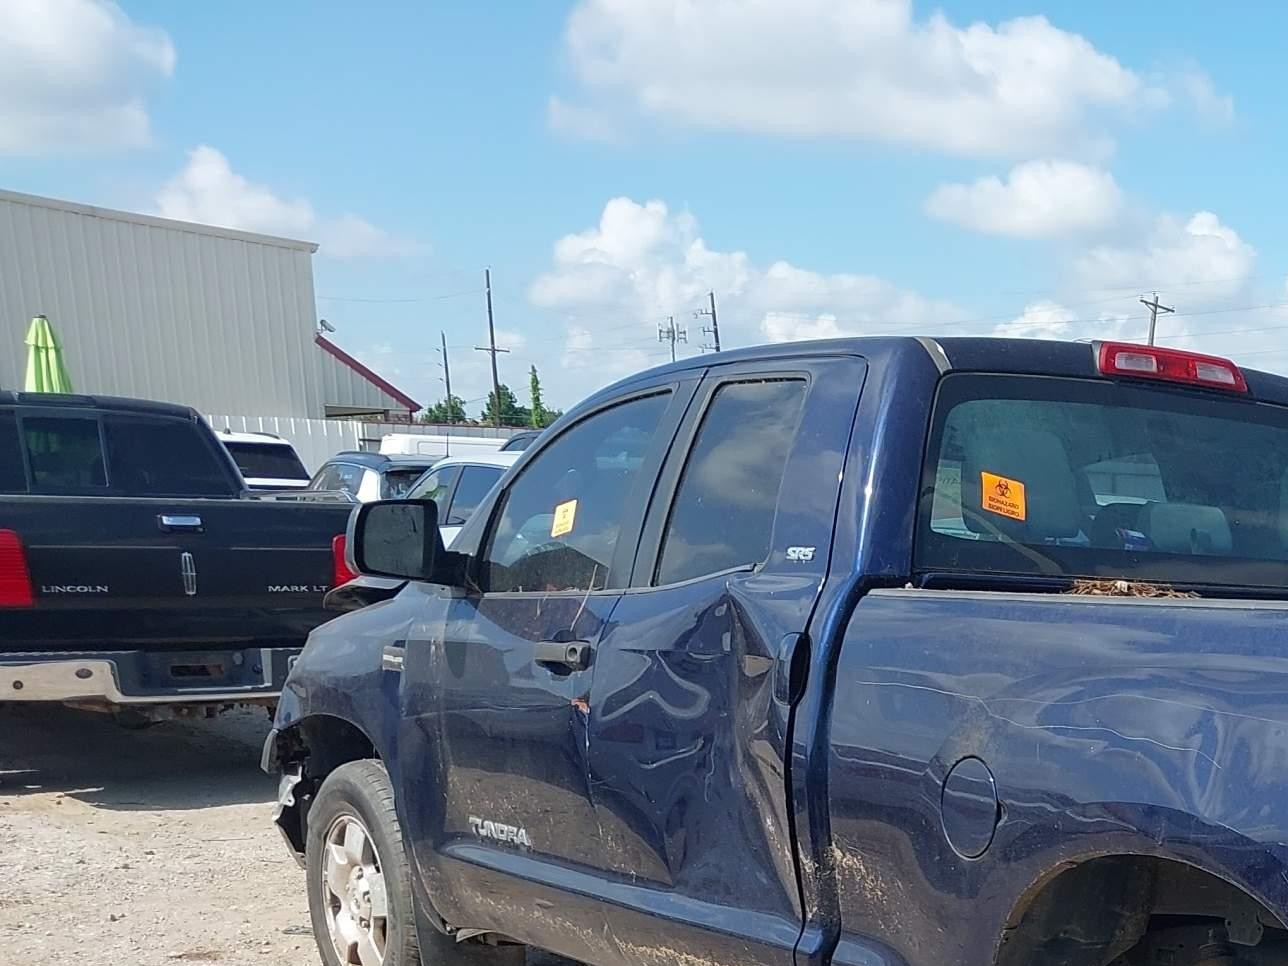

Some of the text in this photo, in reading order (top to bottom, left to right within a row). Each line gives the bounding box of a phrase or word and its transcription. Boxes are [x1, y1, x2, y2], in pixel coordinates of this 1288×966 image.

[786, 546, 816, 560] SR5
[42, 585, 109, 593] LINCOLN
[469, 816, 532, 847] TUNDRA
